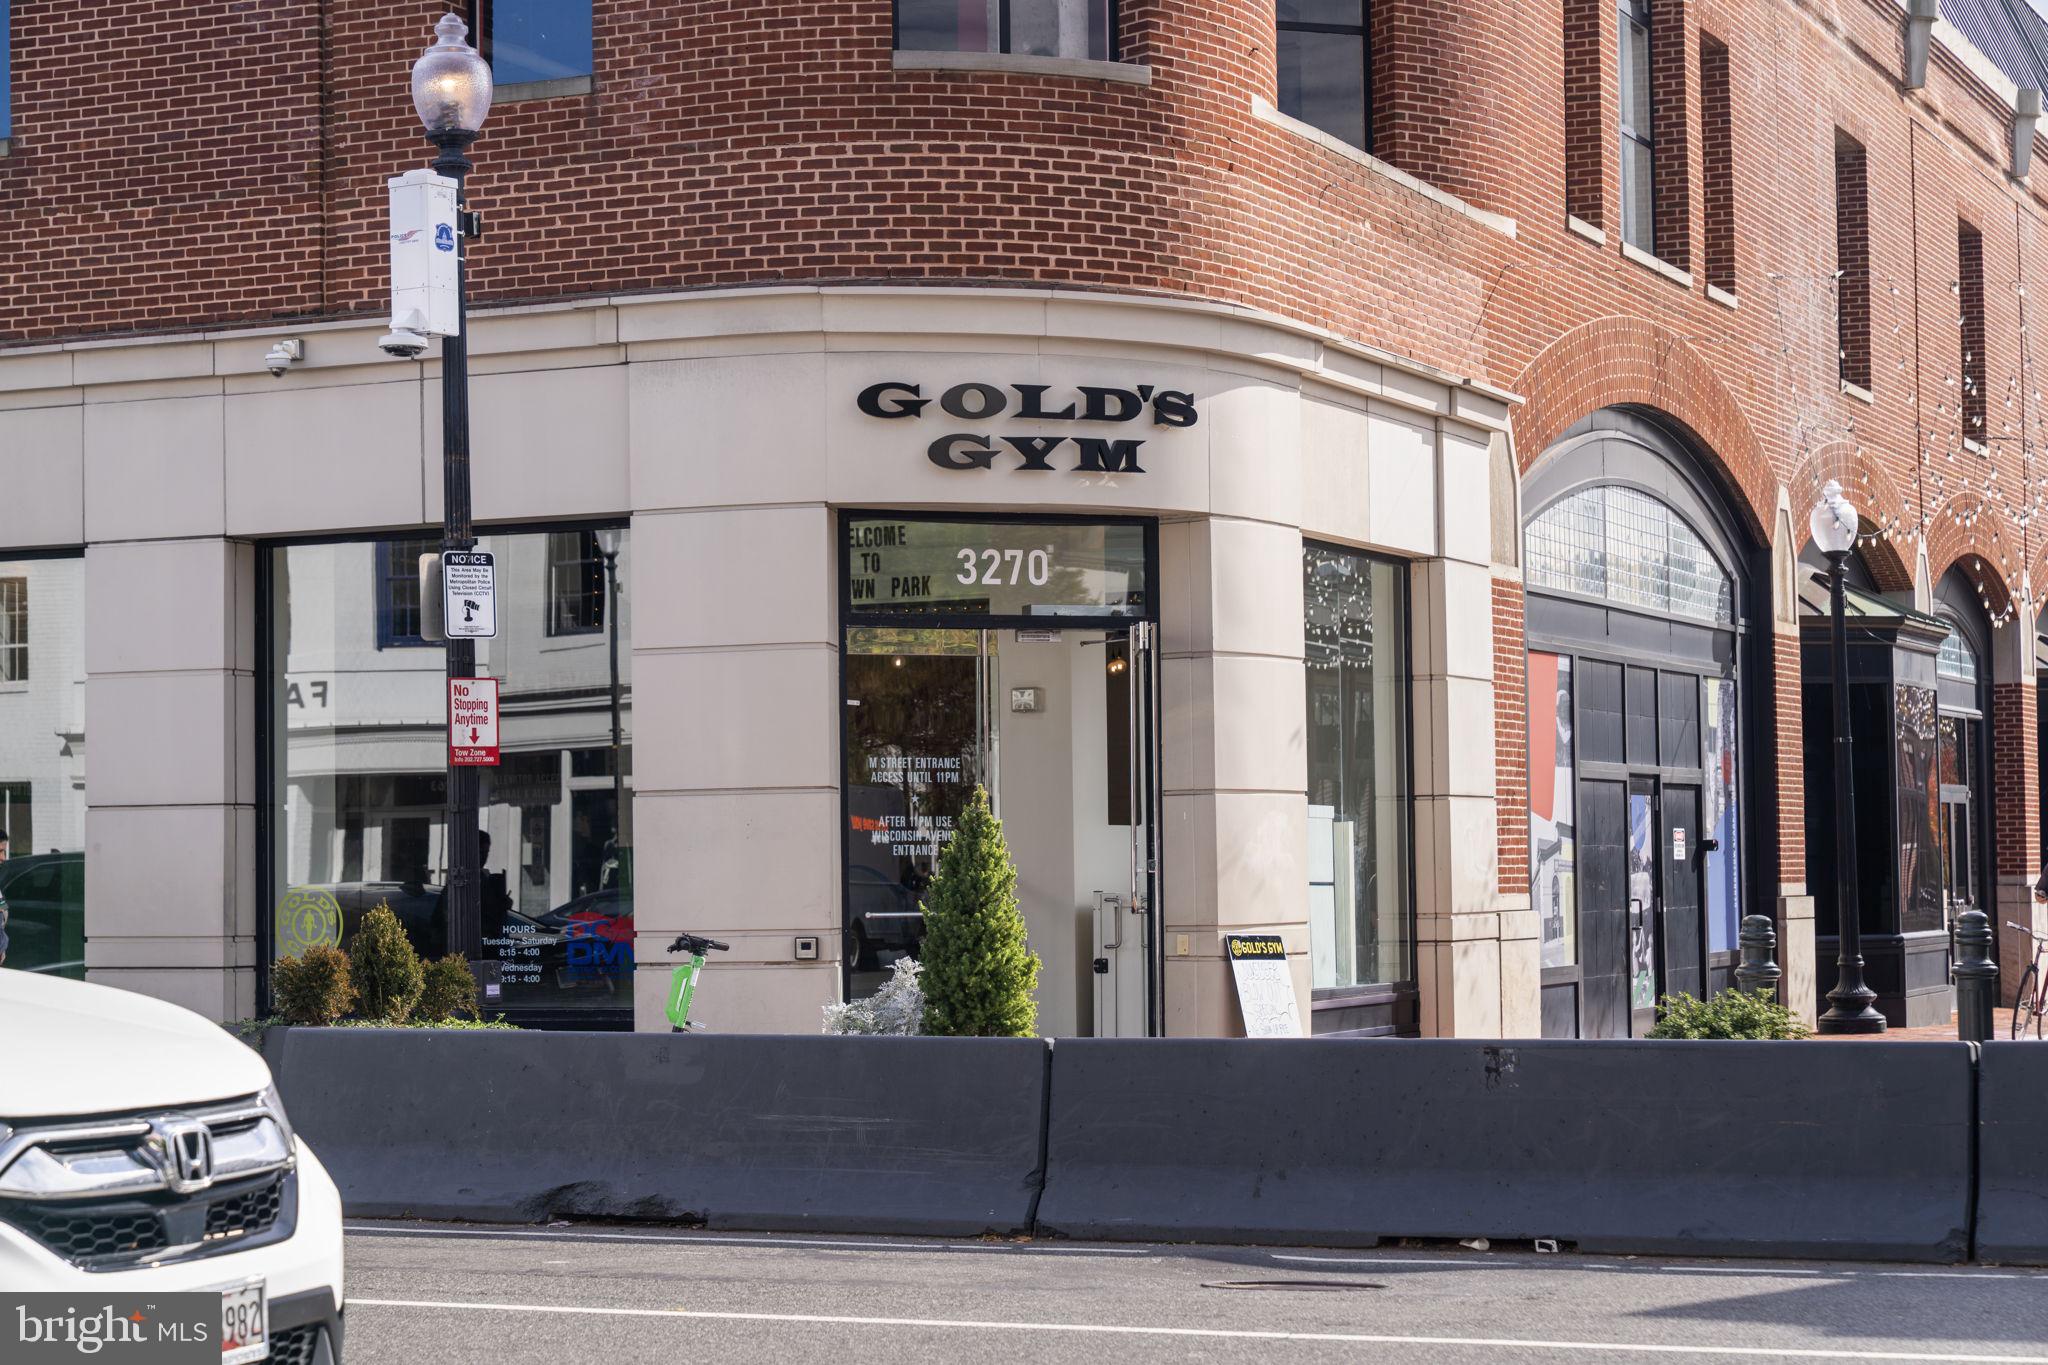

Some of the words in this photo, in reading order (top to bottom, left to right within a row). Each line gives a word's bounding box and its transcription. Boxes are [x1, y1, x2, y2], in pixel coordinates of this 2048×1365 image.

[857, 382, 1198, 427] GOLD'S
[927, 433, 1147, 473] GYM
[860, 552, 880, 573] TO
[957, 548, 1048, 585] 3270
[891, 575, 931, 597] PARK
[454, 684, 469, 696] No
[454, 698, 488, 712] Stopping
[454, 713, 488, 727] Anytime
[454, 748, 468, 756] Tow
[470, 748, 486, 756] Zone
[869, 757, 877, 768] M
[880, 757, 912, 768] STREET
[916, 757, 960, 768] ENTRANCE
[871, 772, 904, 782] ACCESS
[907, 772, 932, 782] UNTIL
[936, 772, 959, 782] 11PM
[878, 816, 906, 827] AFTER
[910, 816, 932, 827] 11PM
[936, 816, 952, 827] USE
[872, 830, 923, 842] WISCONSIN
[893, 844, 938, 856] ENTRANCE
[502, 926, 536, 934] HOURS
[482, 938, 514, 946] Tuesday
[522, 937, 558, 946] Saturday
[500, 948, 516, 956] 8:15
[523, 948, 540, 956] 4:00
[1242, 942, 1267, 954] GOLD'S
[1268, 942, 1284, 954] GYM
[523, 975, 540, 983] 4:00
